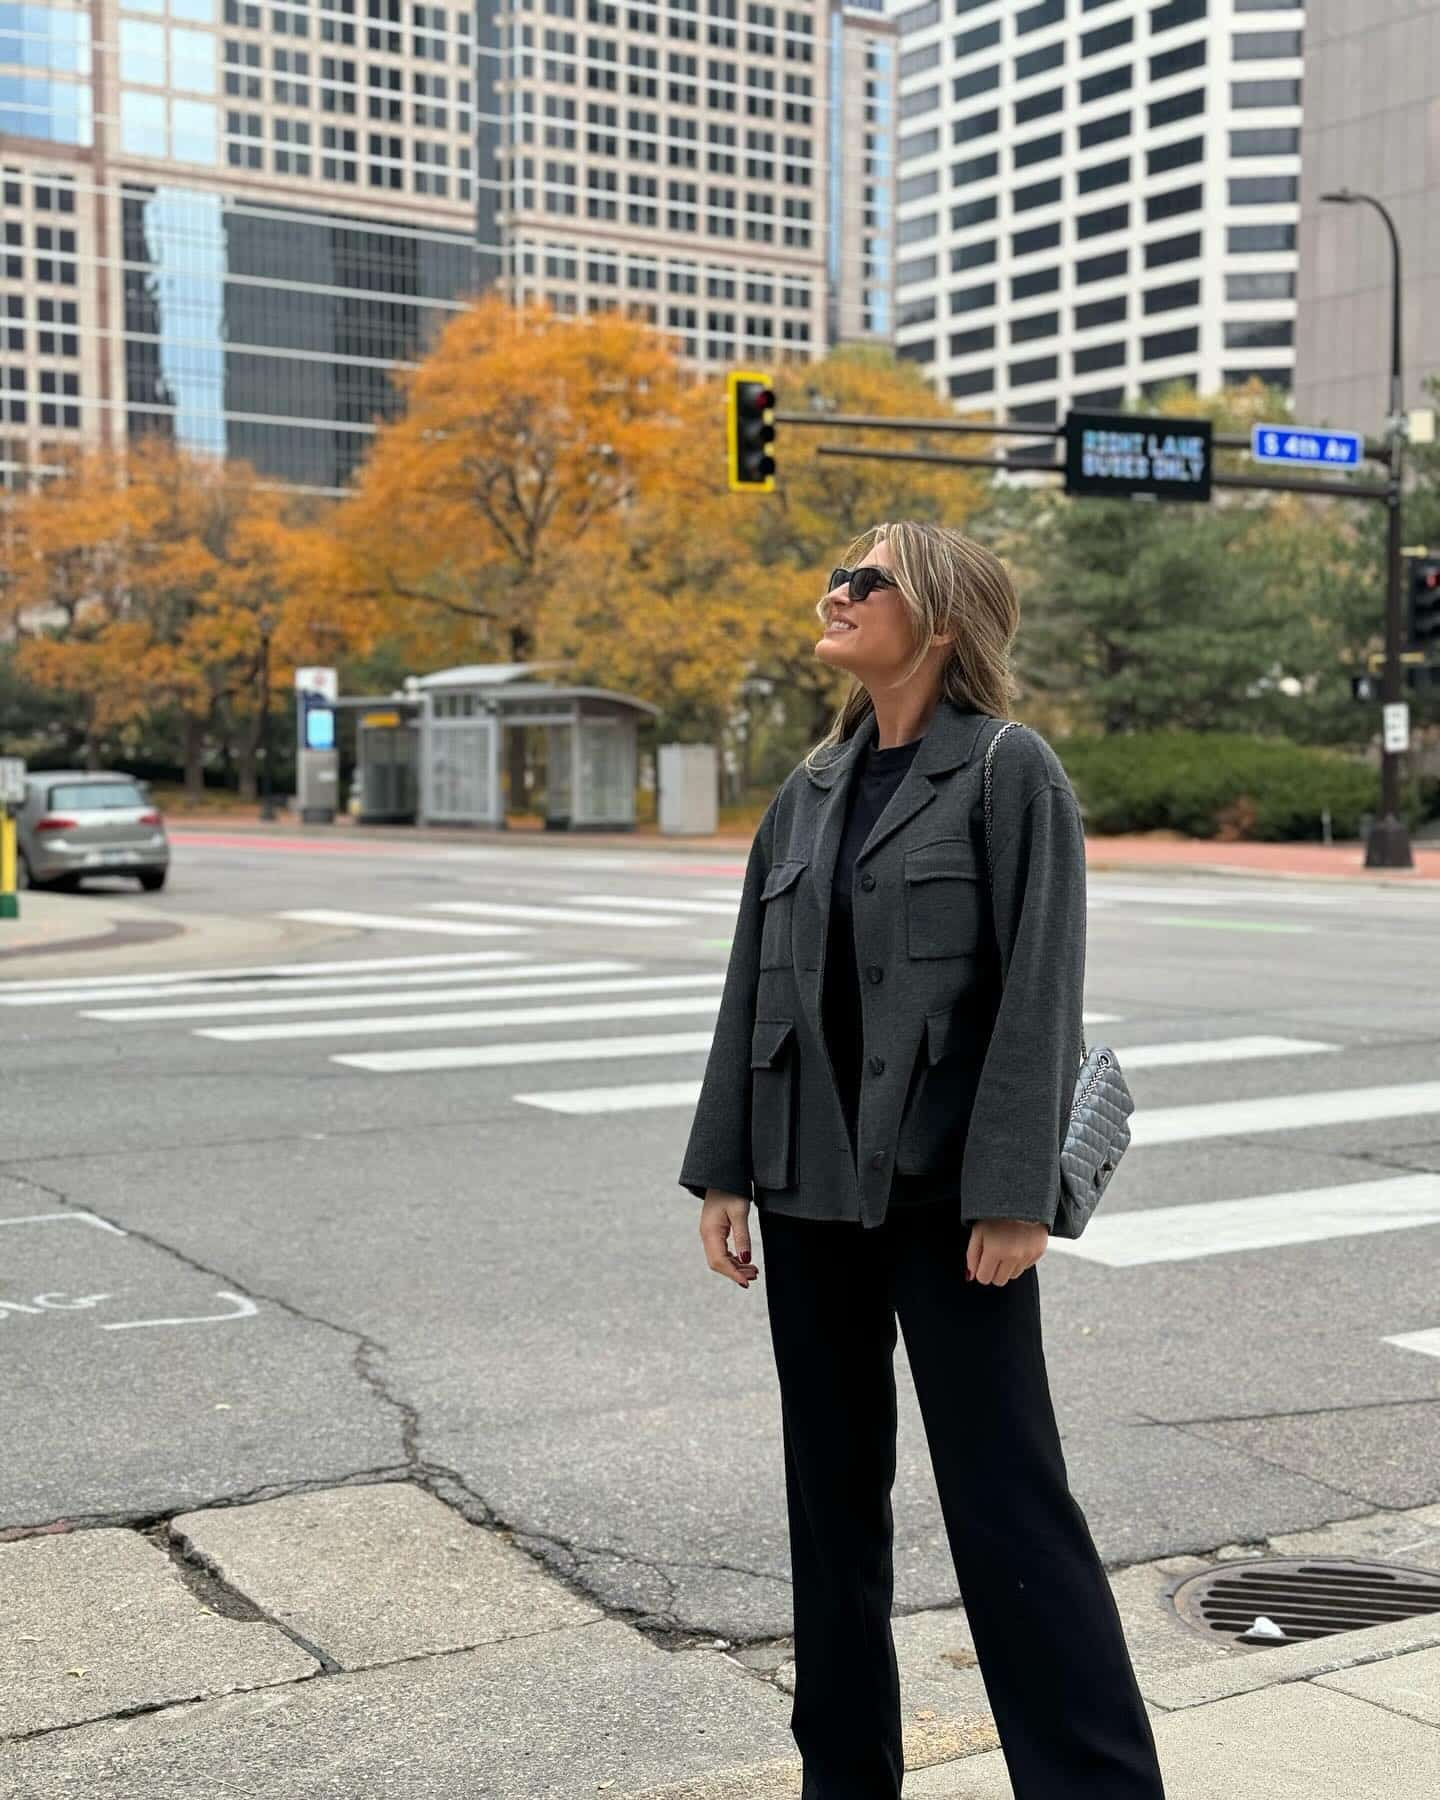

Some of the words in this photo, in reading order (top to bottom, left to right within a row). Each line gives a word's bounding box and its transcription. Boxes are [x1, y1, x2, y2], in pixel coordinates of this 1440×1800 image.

[1147, 434, 1204, 457] LANE
[1264, 432, 1279, 456] S
[1284, 435, 1320, 459] 4th
[1324, 439, 1352, 462] Av
[1082, 454, 1149, 478] BUSES
[1152, 457, 1204, 482] ONLY
